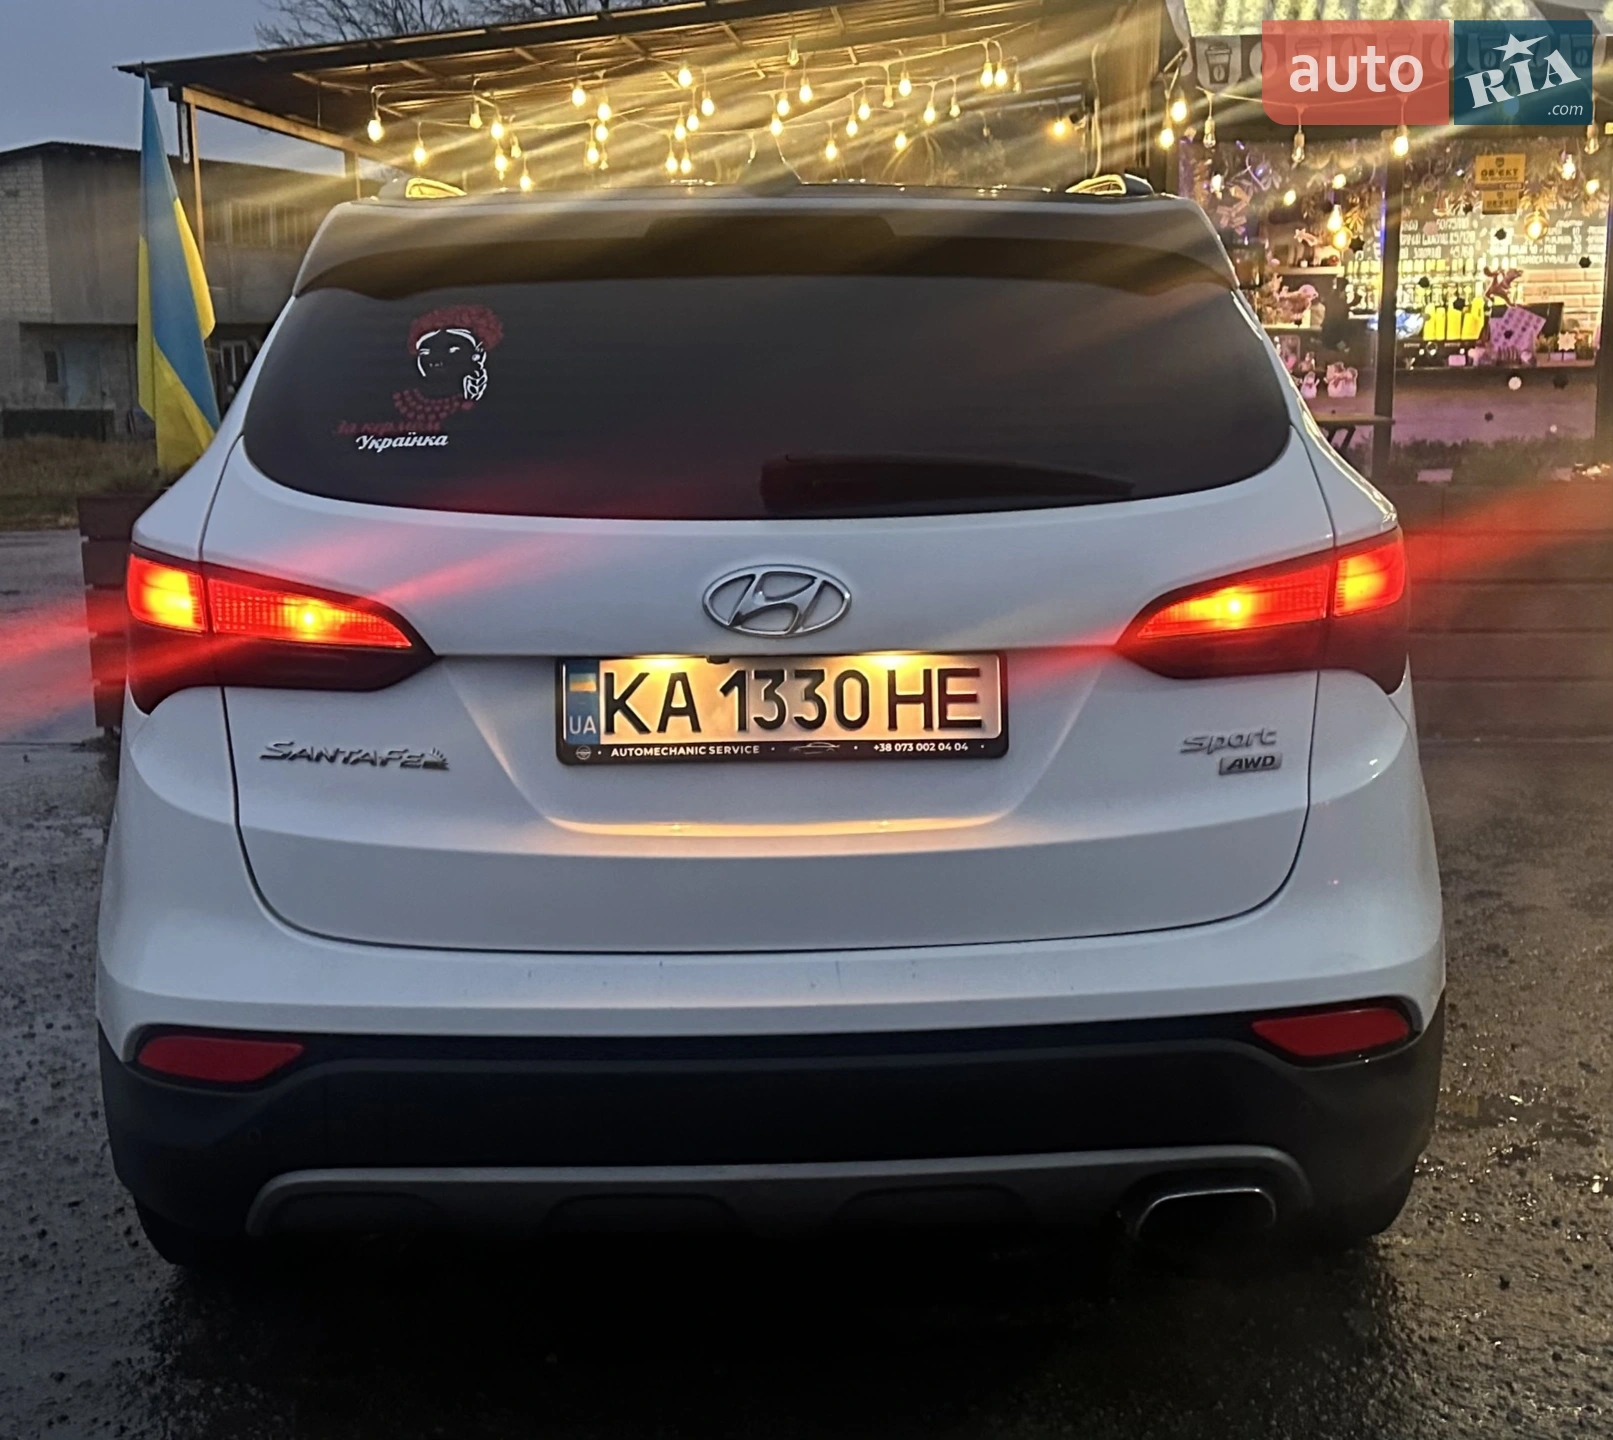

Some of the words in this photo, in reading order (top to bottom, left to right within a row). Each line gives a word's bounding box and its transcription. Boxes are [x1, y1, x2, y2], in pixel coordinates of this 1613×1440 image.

[355, 431, 449, 453] Українка
[604, 672, 703, 734] KA
[719, 669, 870, 732] 1330
[887, 667, 983, 732] HE
[569, 715, 597, 735] UA
[611, 746, 706, 757] AUTOMECHANIC
[708, 745, 760, 755] SERVICE
[873, 743, 892, 752] +38
[894, 743, 914, 752] 073
[916, 742, 936, 752] 002
[938, 742, 952, 751] 04
[954, 742, 969, 751] 04
[1226, 755, 1276, 771] AWD
